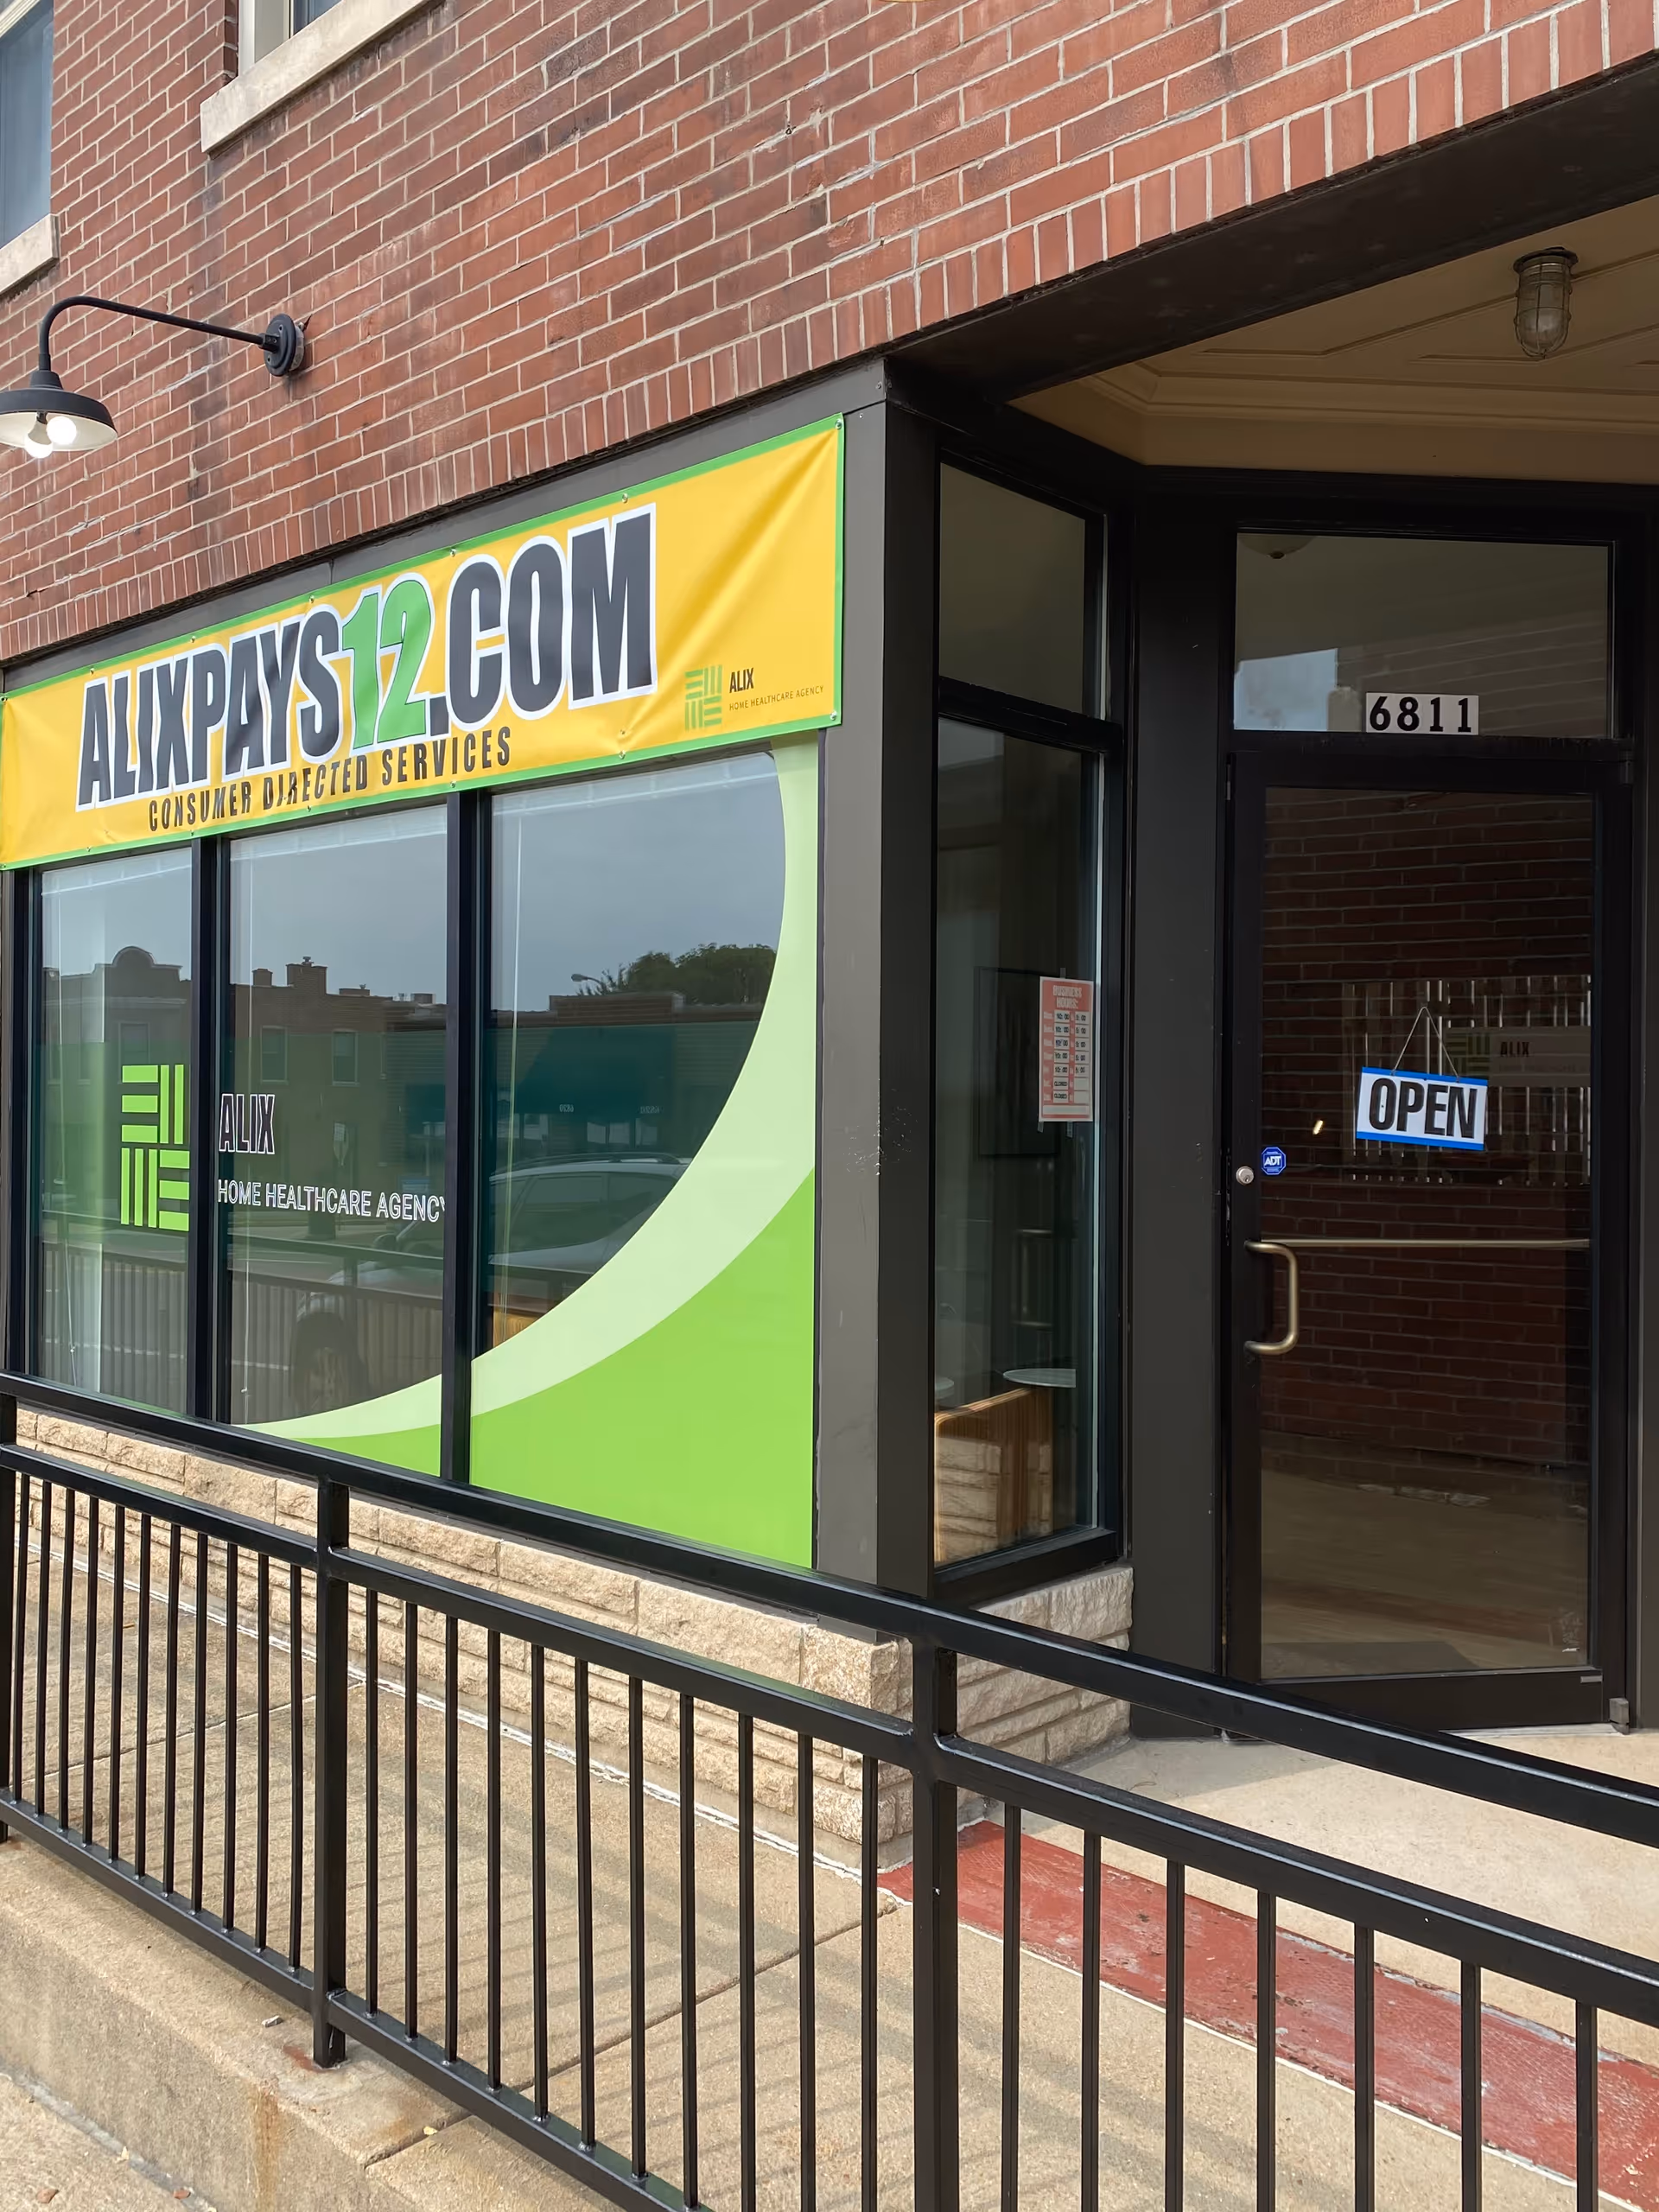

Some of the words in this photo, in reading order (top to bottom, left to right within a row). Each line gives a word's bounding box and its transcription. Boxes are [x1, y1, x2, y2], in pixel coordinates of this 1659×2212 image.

[76, 503, 657, 812] ALIXPAYS12.COM
[729, 667, 754, 693] ALIX
[729, 699, 749, 711] HOME
[751, 690, 794, 708] HEALTHCARE
[796, 685, 824, 698] AGENCY
[1370, 696, 1471, 733] 6811
[149, 780, 251, 832] CONSUMER
[263, 754, 367, 810] DIRECTED
[382, 726, 511, 785] SERVICES
[219, 1093, 276, 1154] ALIX
[1368, 1077, 1478, 1140] OPEN
[1263, 1155, 1282, 1166] ADT
[218, 1179, 262, 1207] HOME
[265, 1184, 372, 1217] HEALTHCARE
